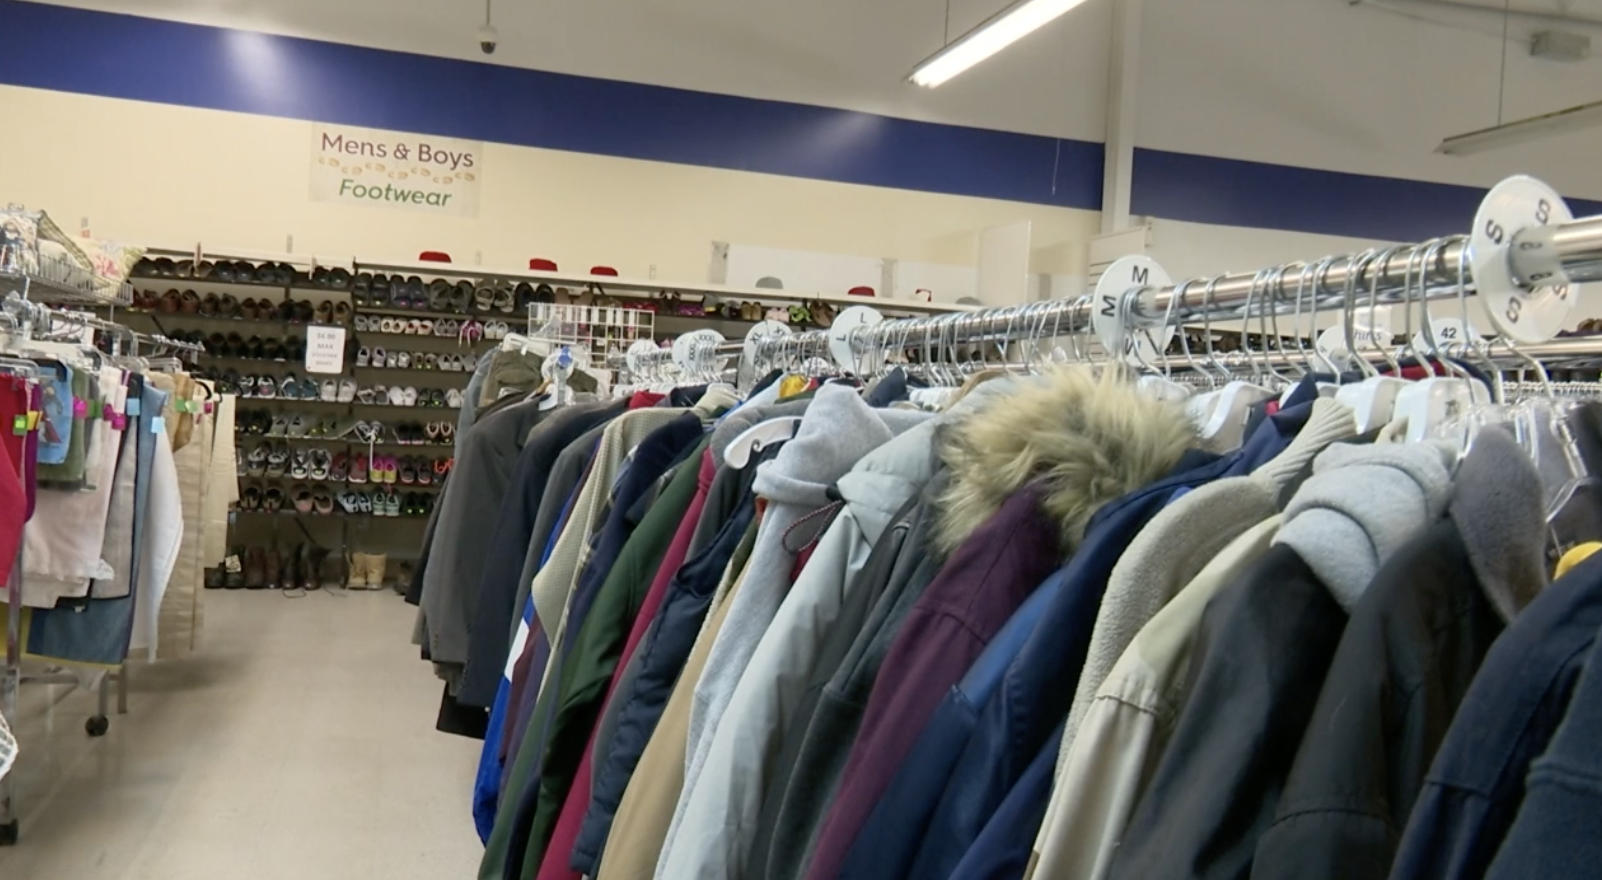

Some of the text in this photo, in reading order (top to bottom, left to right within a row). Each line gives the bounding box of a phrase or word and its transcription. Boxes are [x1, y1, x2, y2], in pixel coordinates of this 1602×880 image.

[321, 132, 474, 171] Mens & Boys
[338, 178, 452, 206] Footwear
[1485, 219, 1504, 245] S
[1131, 265, 1149, 286] M
[859, 312, 867, 324] L
[1101, 294, 1117, 318] M
[1441, 327, 1457, 340] 42
